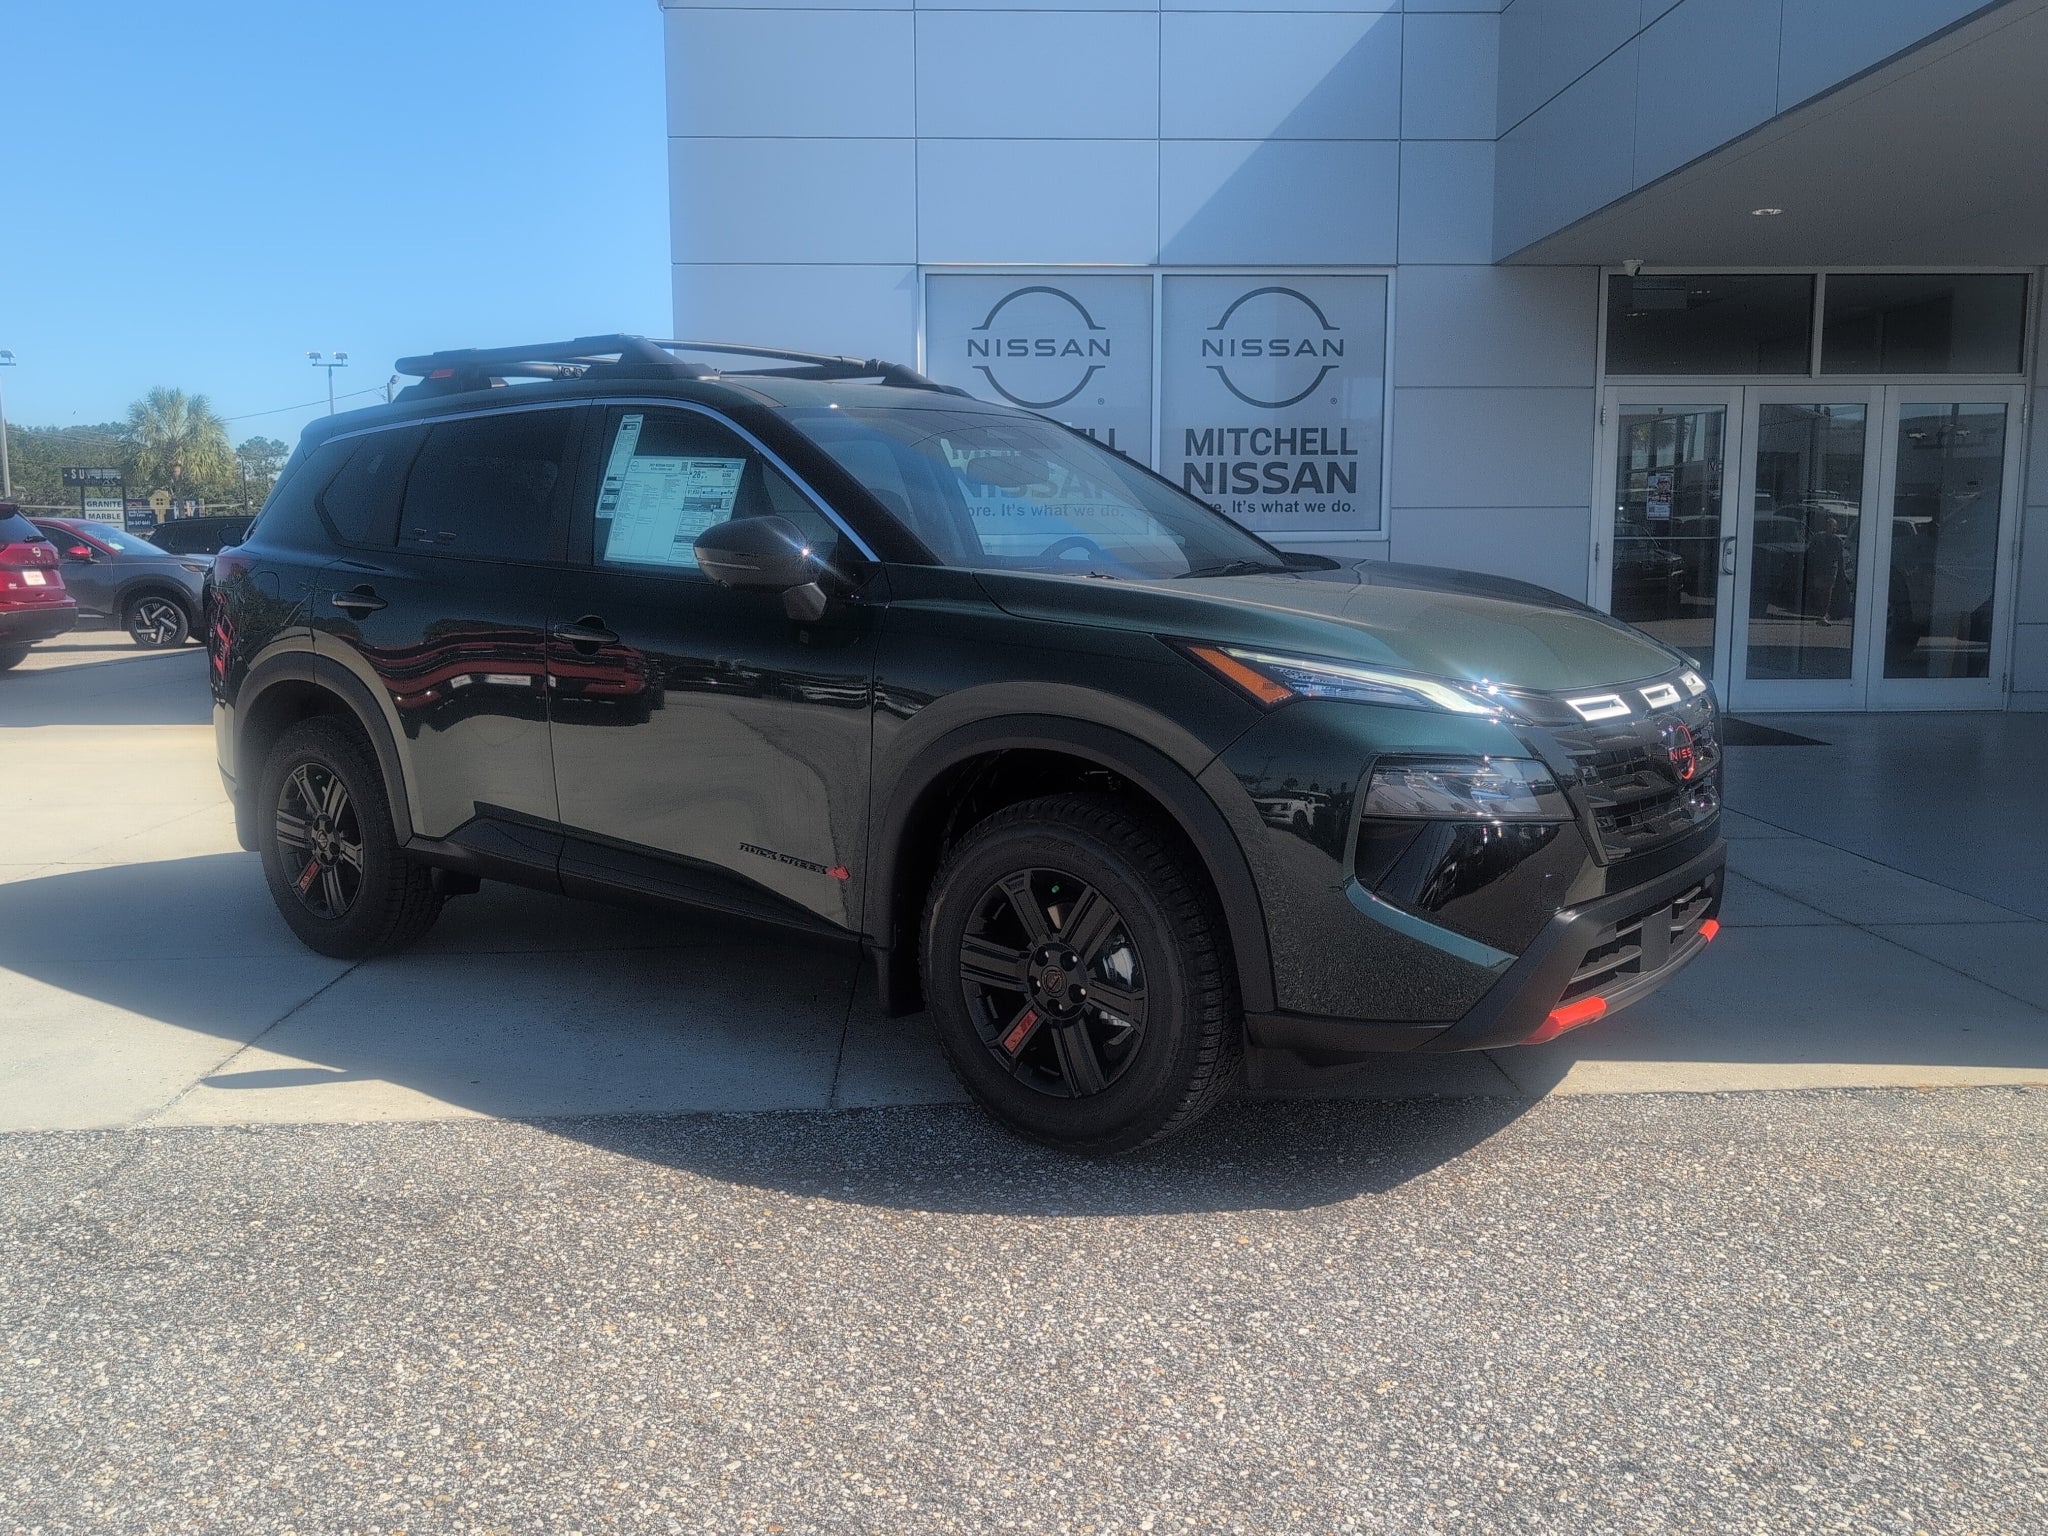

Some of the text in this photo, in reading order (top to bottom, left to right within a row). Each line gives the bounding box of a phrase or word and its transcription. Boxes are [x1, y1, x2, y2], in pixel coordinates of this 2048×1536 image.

[967, 338, 1111, 357] NISSAN
[1202, 338, 1344, 357] NISSAN
[1185, 427, 1358, 457] MITCHELL
[1183, 461, 1357, 495] NISSAN
[86, 500, 122, 508] GRANITE
[969, 503, 1125, 517] ore. It's what we do.
[1232, 500, 1256, 513] It's
[1261, 500, 1299, 513] what
[1304, 502, 1326, 513] we
[1331, 500, 1356, 513] do.
